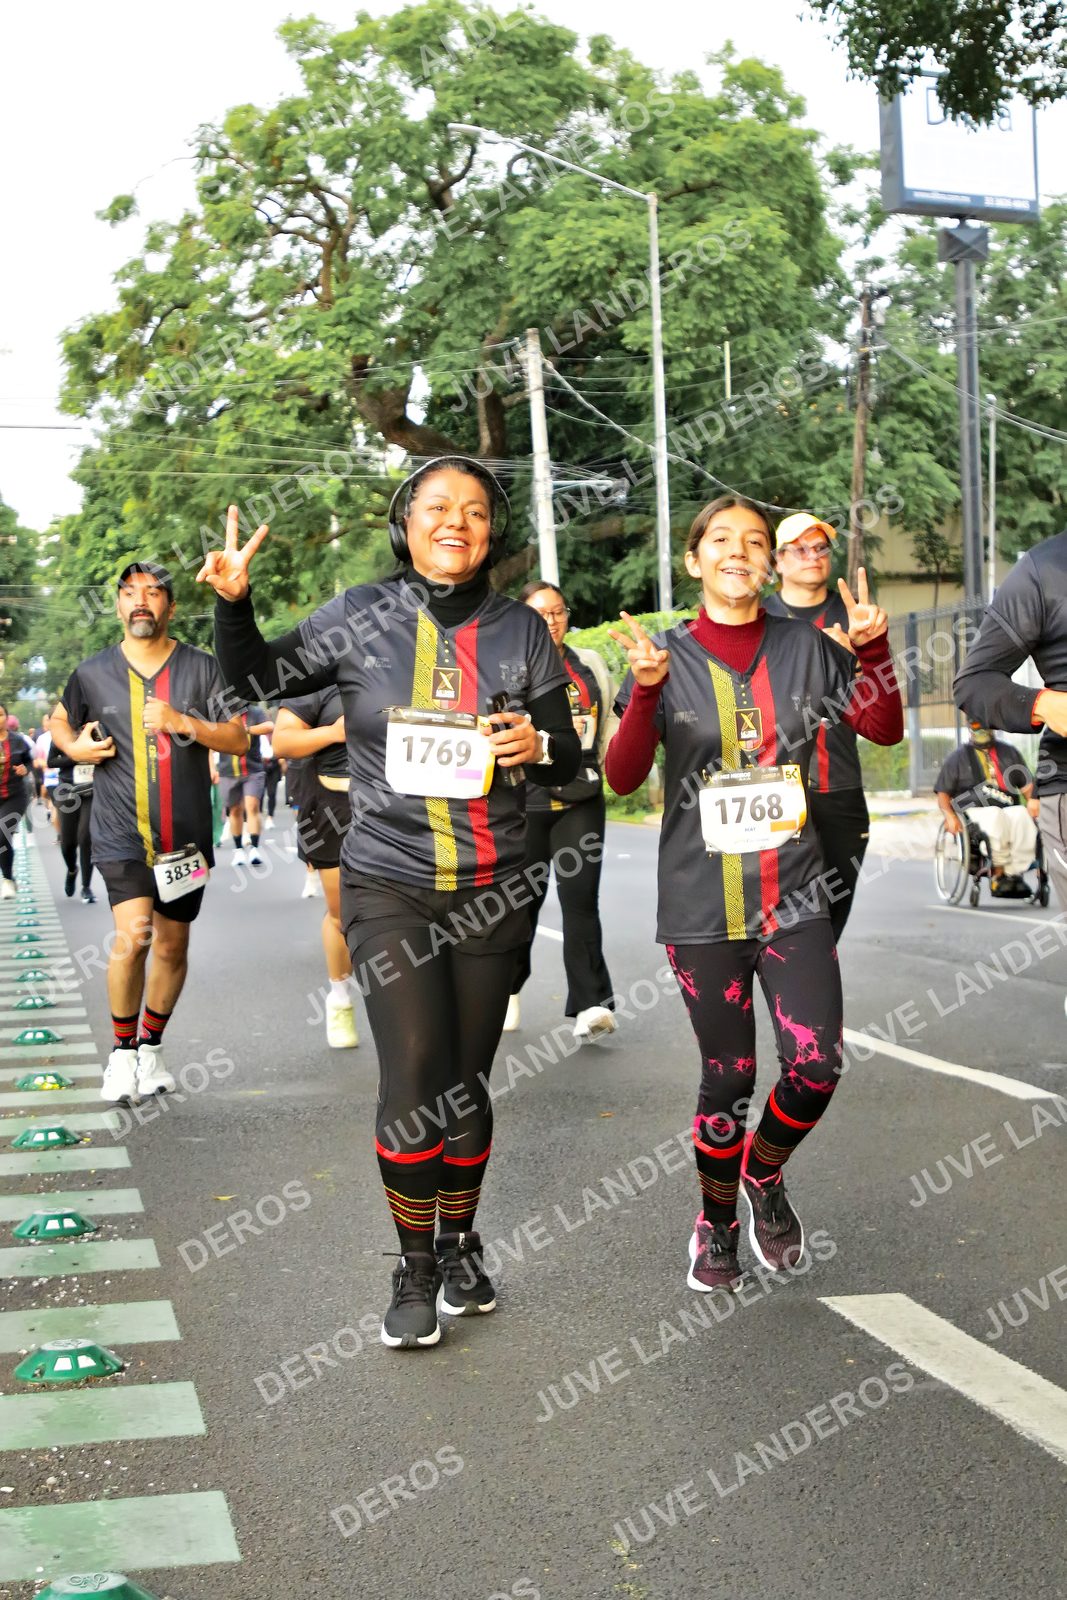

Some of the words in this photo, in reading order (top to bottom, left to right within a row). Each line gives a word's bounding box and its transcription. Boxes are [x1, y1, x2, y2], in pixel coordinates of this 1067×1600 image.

[402, 735, 472, 768] 1769
[714, 793, 784, 825] 1768
[164, 860, 200, 885] 3833
